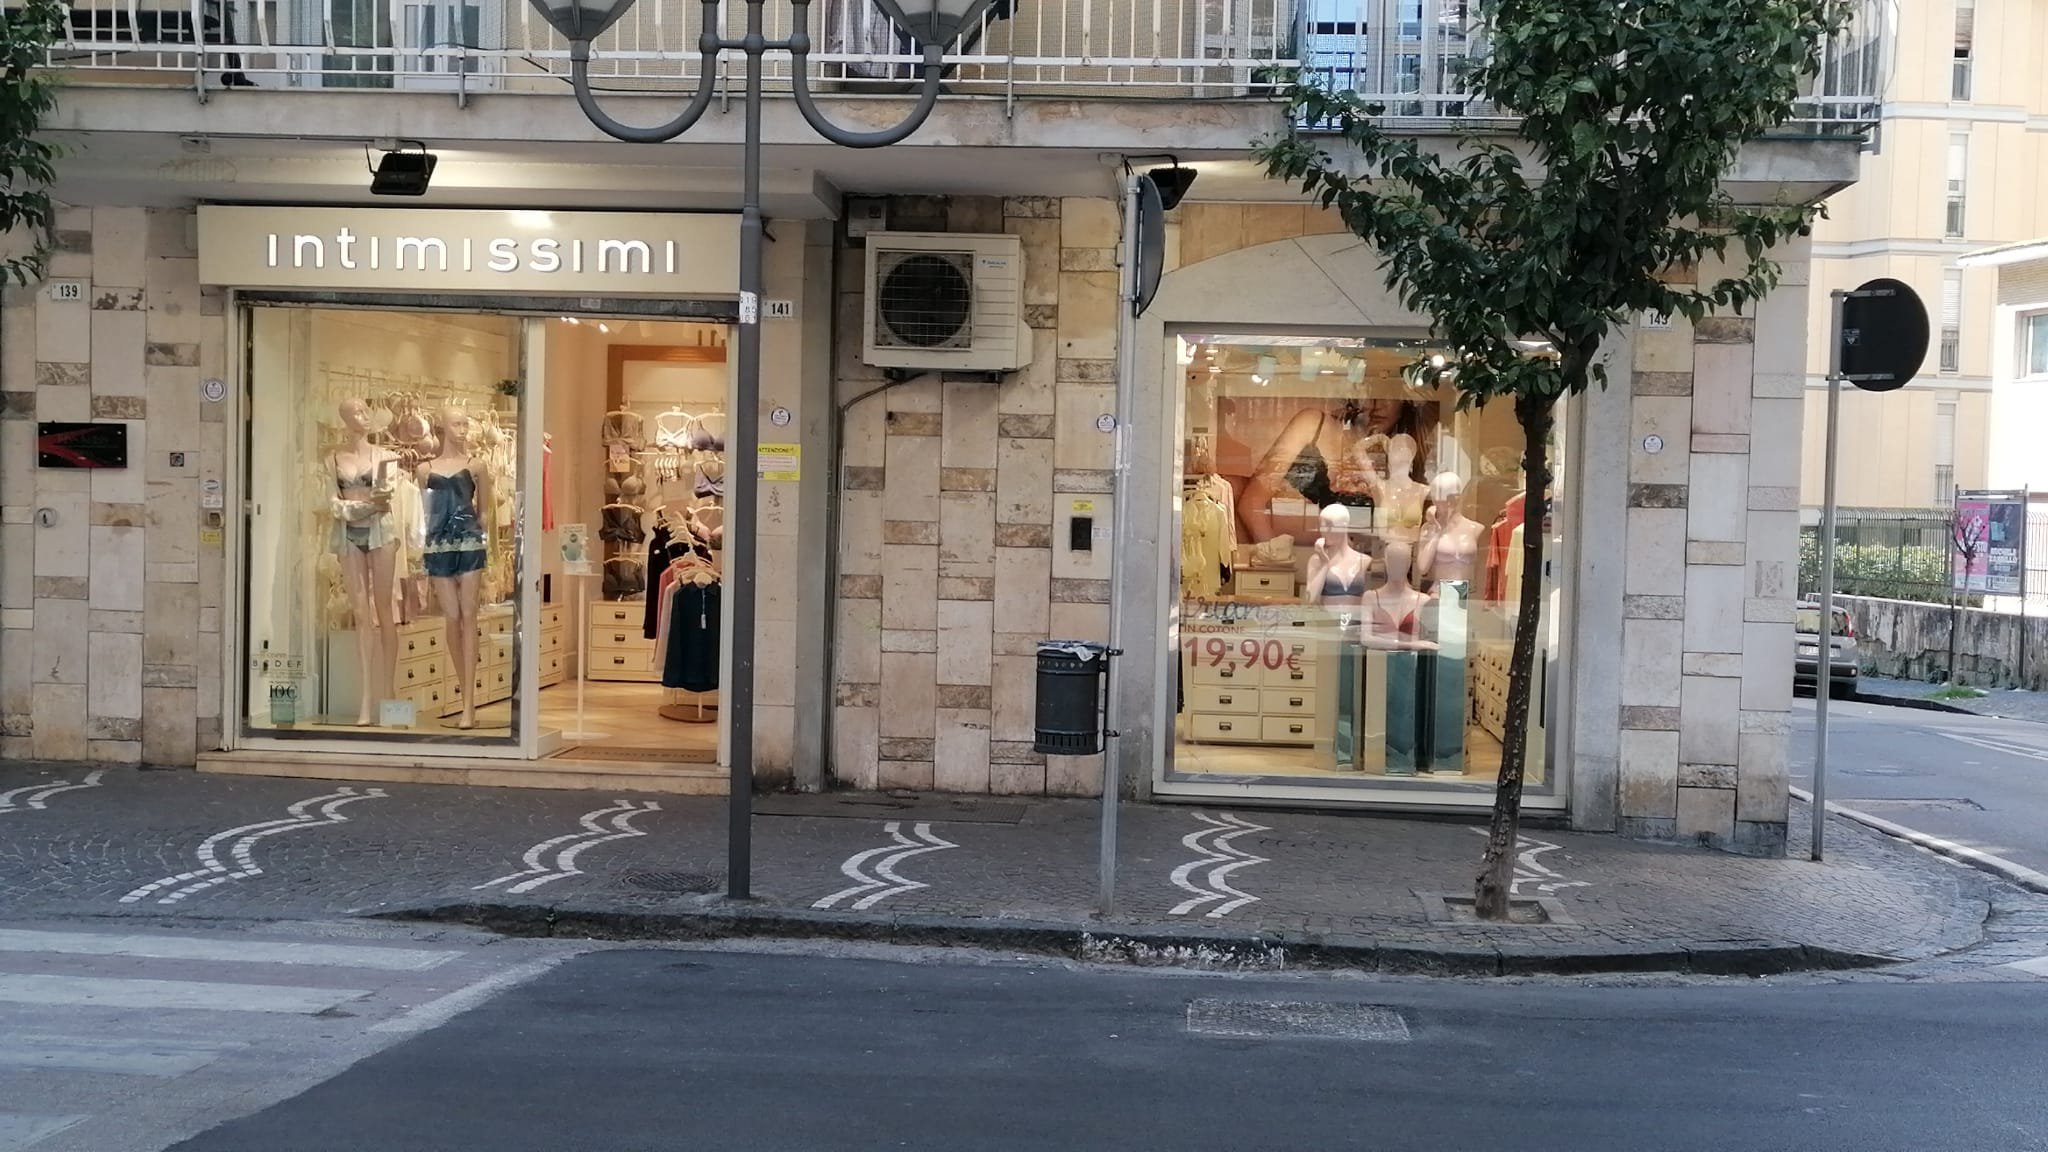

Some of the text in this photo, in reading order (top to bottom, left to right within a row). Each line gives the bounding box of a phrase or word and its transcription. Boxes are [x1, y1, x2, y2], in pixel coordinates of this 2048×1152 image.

[267, 226, 678, 274] intimissimi
[60, 284, 78, 297] 139
[772, 303, 789, 315] 141
[1650, 312, 1668, 325] 143
[1183, 624, 1246, 634] IN COTONE
[1183, 636, 1302, 671] 19,90€
